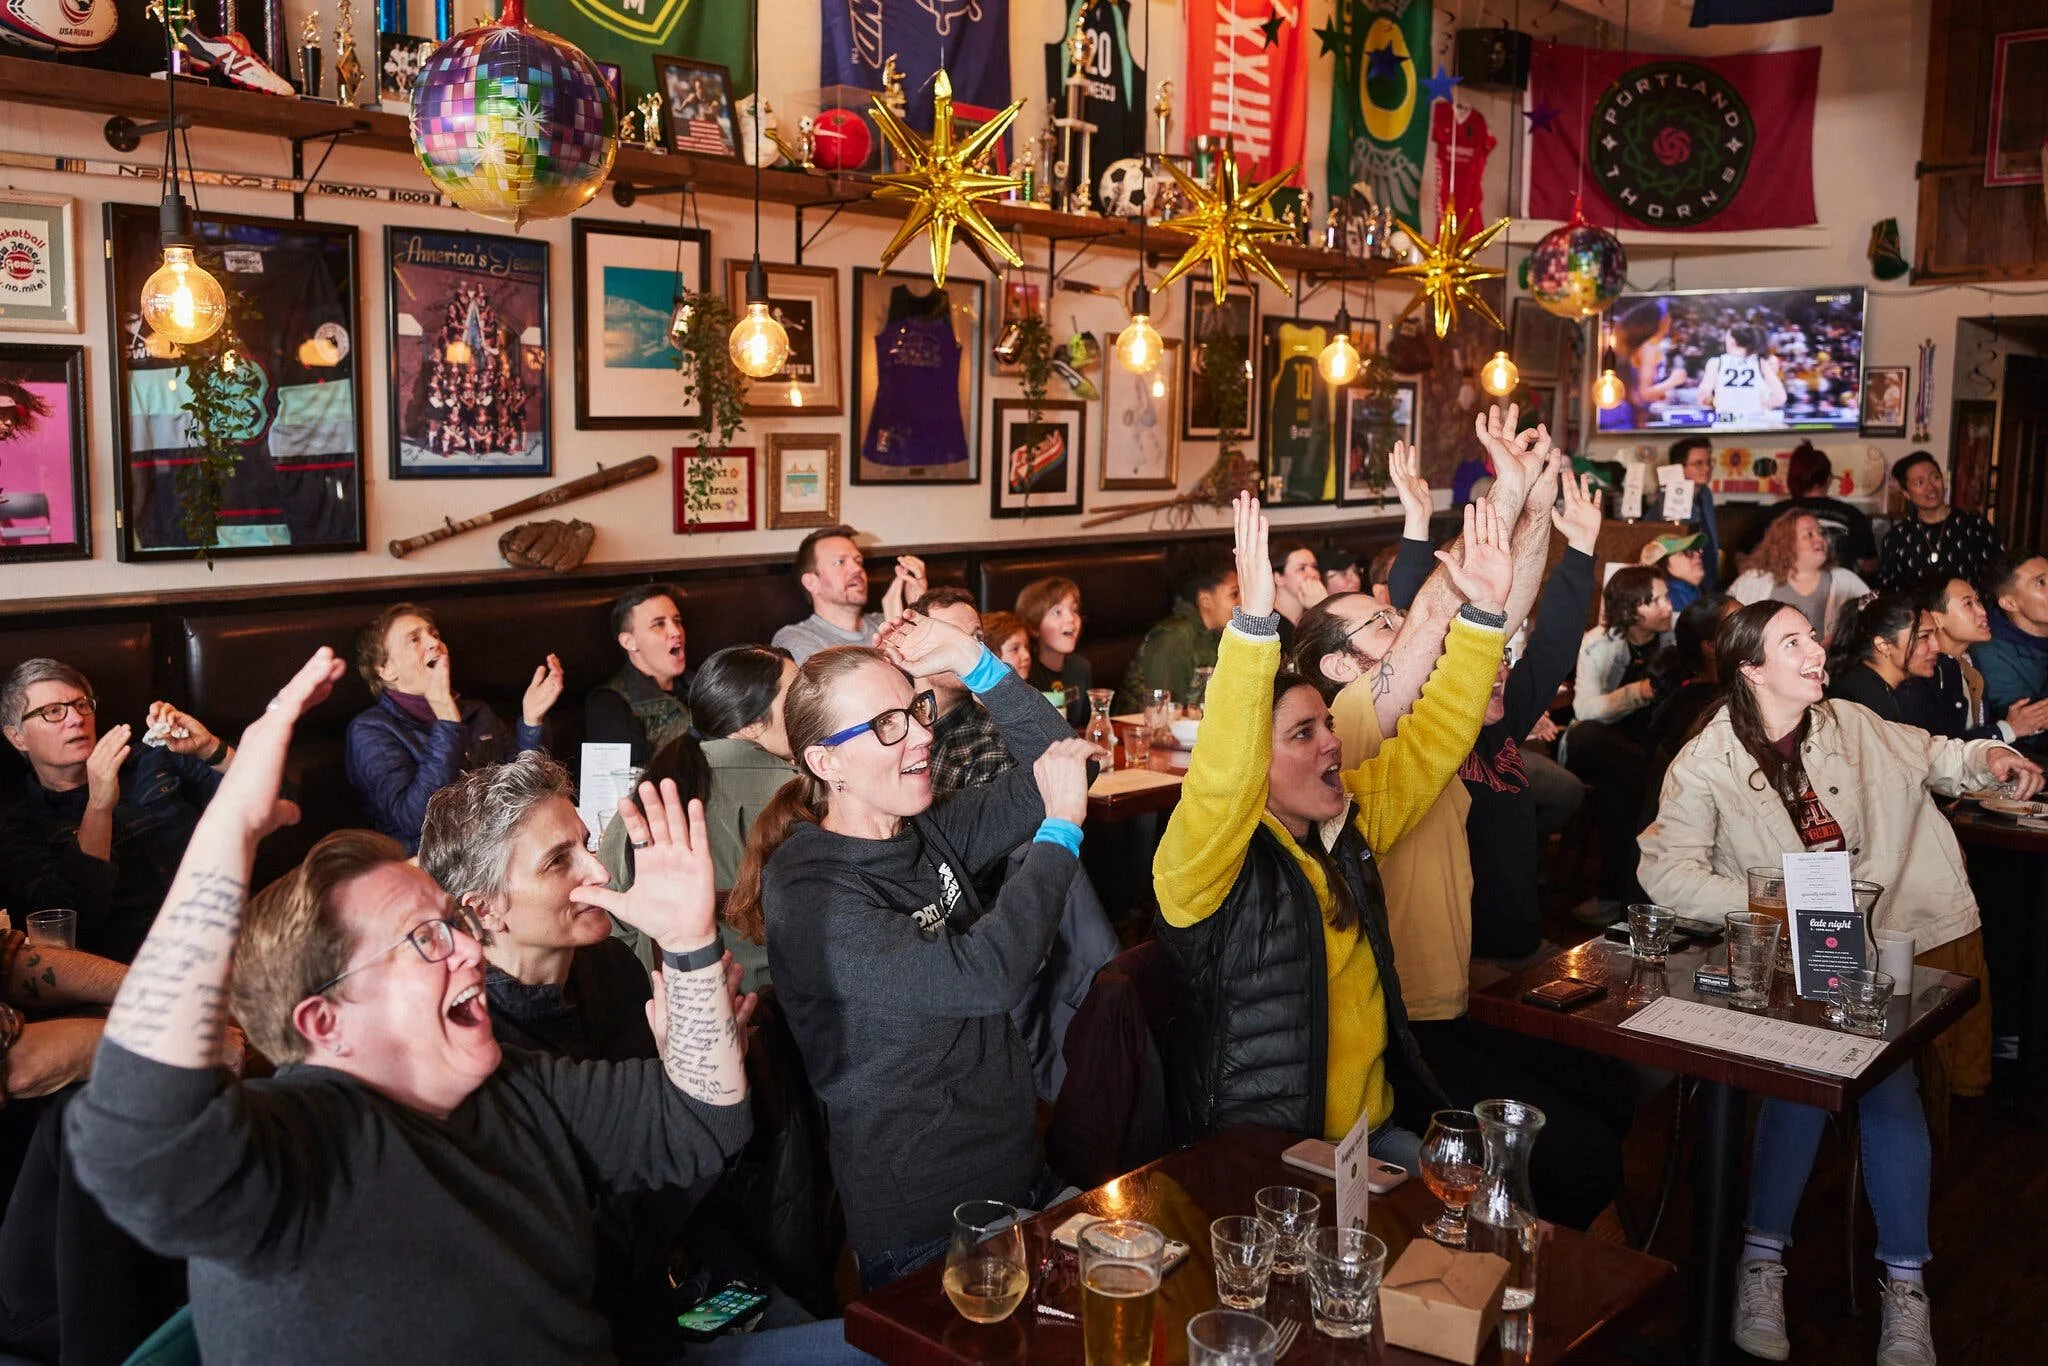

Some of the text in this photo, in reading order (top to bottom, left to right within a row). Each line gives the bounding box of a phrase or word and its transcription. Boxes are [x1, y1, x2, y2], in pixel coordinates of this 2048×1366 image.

[1604, 73, 1740, 128] PORTLAND
[317, 183, 378, 199] CANADIEN
[1606, 166, 1737, 218] THORNS
[0, 229, 46, 249] sketball
[394, 235, 488, 268] America's
[1724, 369, 1755, 387] 22
[709, 485, 738, 495] trans
[1827, 919, 1852, 931] night
